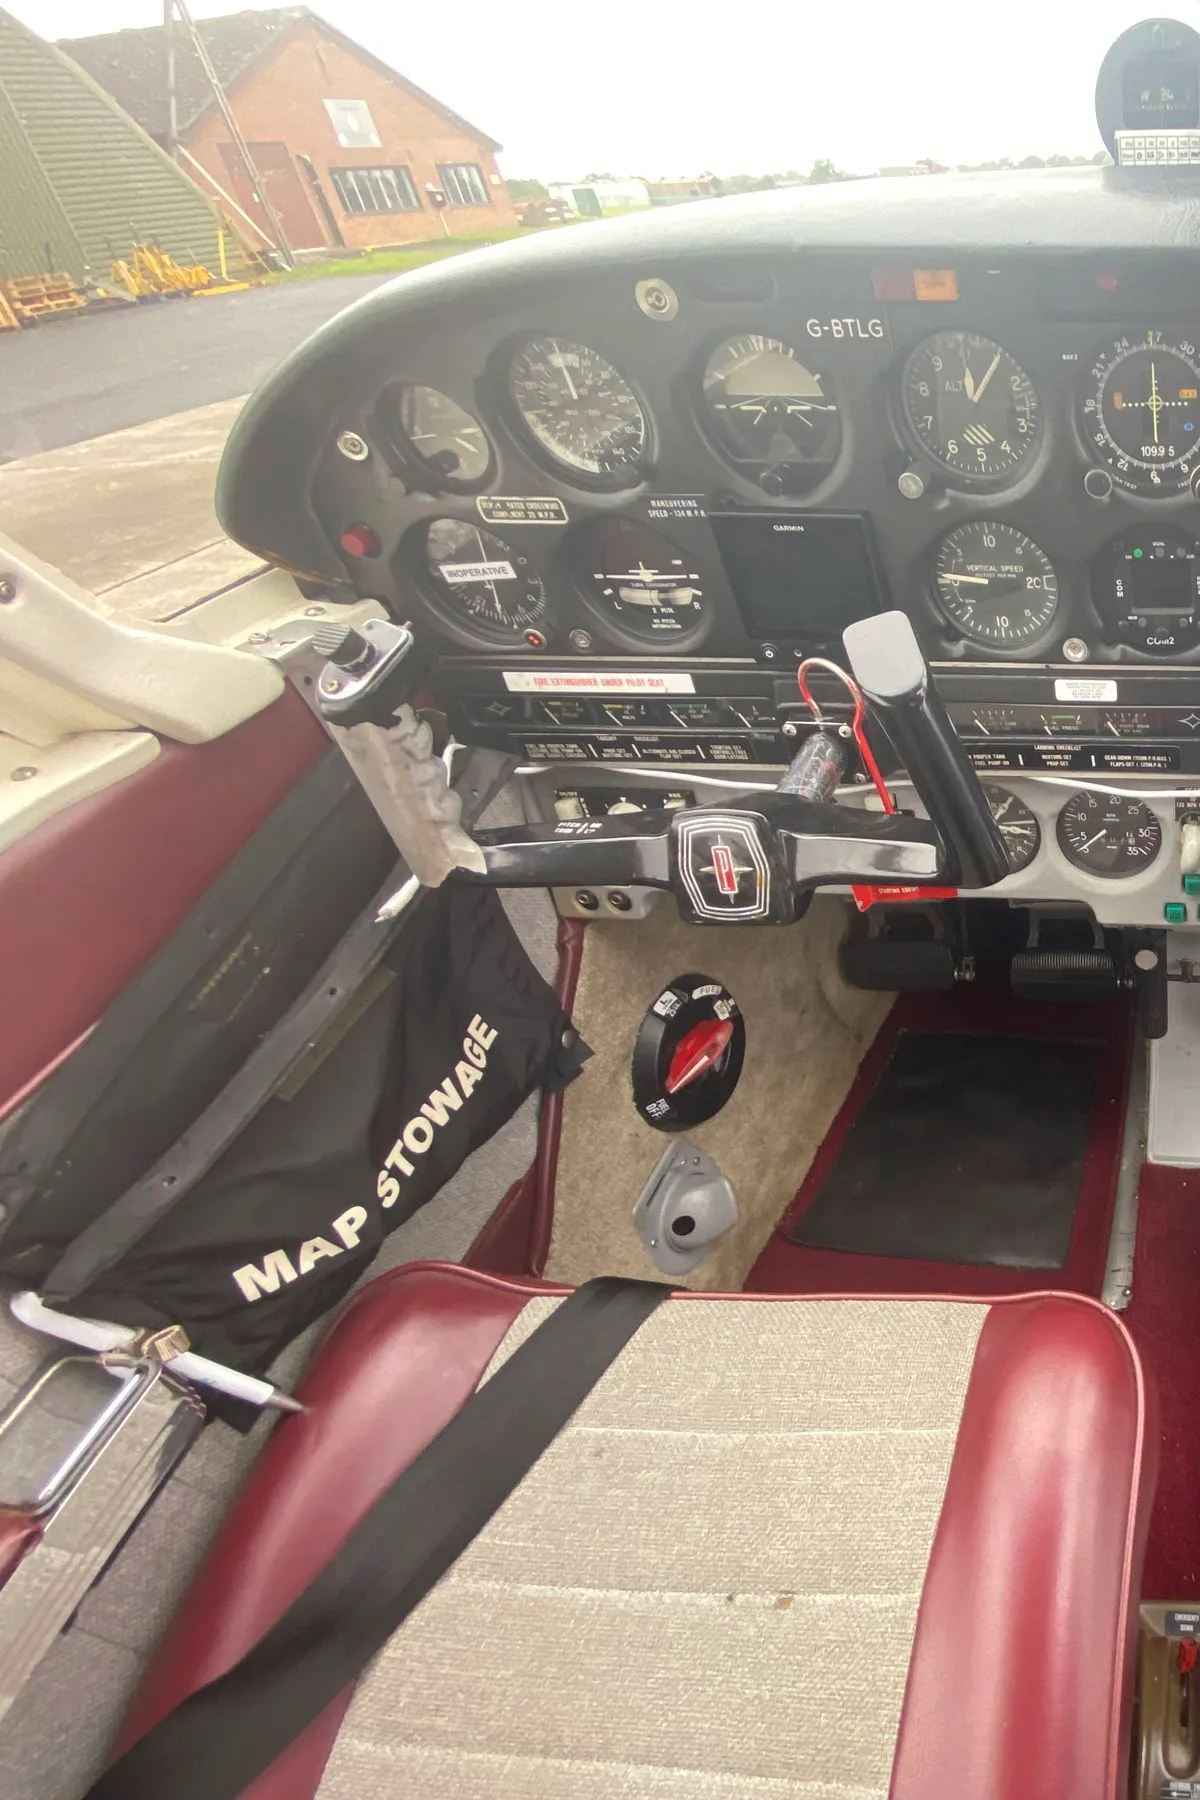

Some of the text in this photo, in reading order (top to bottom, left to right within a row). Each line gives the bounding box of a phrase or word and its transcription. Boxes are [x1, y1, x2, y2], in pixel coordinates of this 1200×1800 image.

[806, 318, 884, 338] G-BTLG
[1113, 337, 1130, 352] 24
[1180, 340, 1195, 355] 30
[931, 355, 943, 372] 9
[1091, 362, 1106, 378] 21
[918, 381, 930, 397] 8
[944, 380, 963, 393] ALT
[1010, 375, 1022, 391] 2
[923, 415, 933, 430] 7
[1016, 417, 1028, 433] 3
[947, 439, 959, 455] 6
[1000, 439, 1012, 454] 4
[976, 447, 987, 462] 5
[650, 499, 698, 508] MANEUVERING
[647, 509, 667, 518] SPEED
[772, 524, 805, 532] GARMIN
[982, 534, 996, 548] 10
[446, 566, 510, 578] INOPERATIVE
[966, 564, 1024, 573] VERTICAL SPEED
[1025, 577, 1041, 590] 20
[613, 602, 621, 611] L
[650, 606, 656, 614] 2
[692, 602, 700, 610] R
[995, 615, 1009, 628] 10
[601, 677, 622, 688] UNDER
[625, 678, 646, 688] PILOT
[647, 678, 665, 688] SEAT
[1088, 798, 1097, 808] 15
[1109, 795, 1121, 805] 20
[1077, 812, 1087, 821] 10
[1127, 805, 1139, 815] 25
[1080, 831, 1087, 840] 5
[1138, 828, 1151, 838] 30
[1126, 846, 1139, 856] 35
[646, 1103, 662, 1119] OFF
[656, 1098, 670, 1113] FUEL
[232, 1012, 499, 1304] MAP STOWAGE
